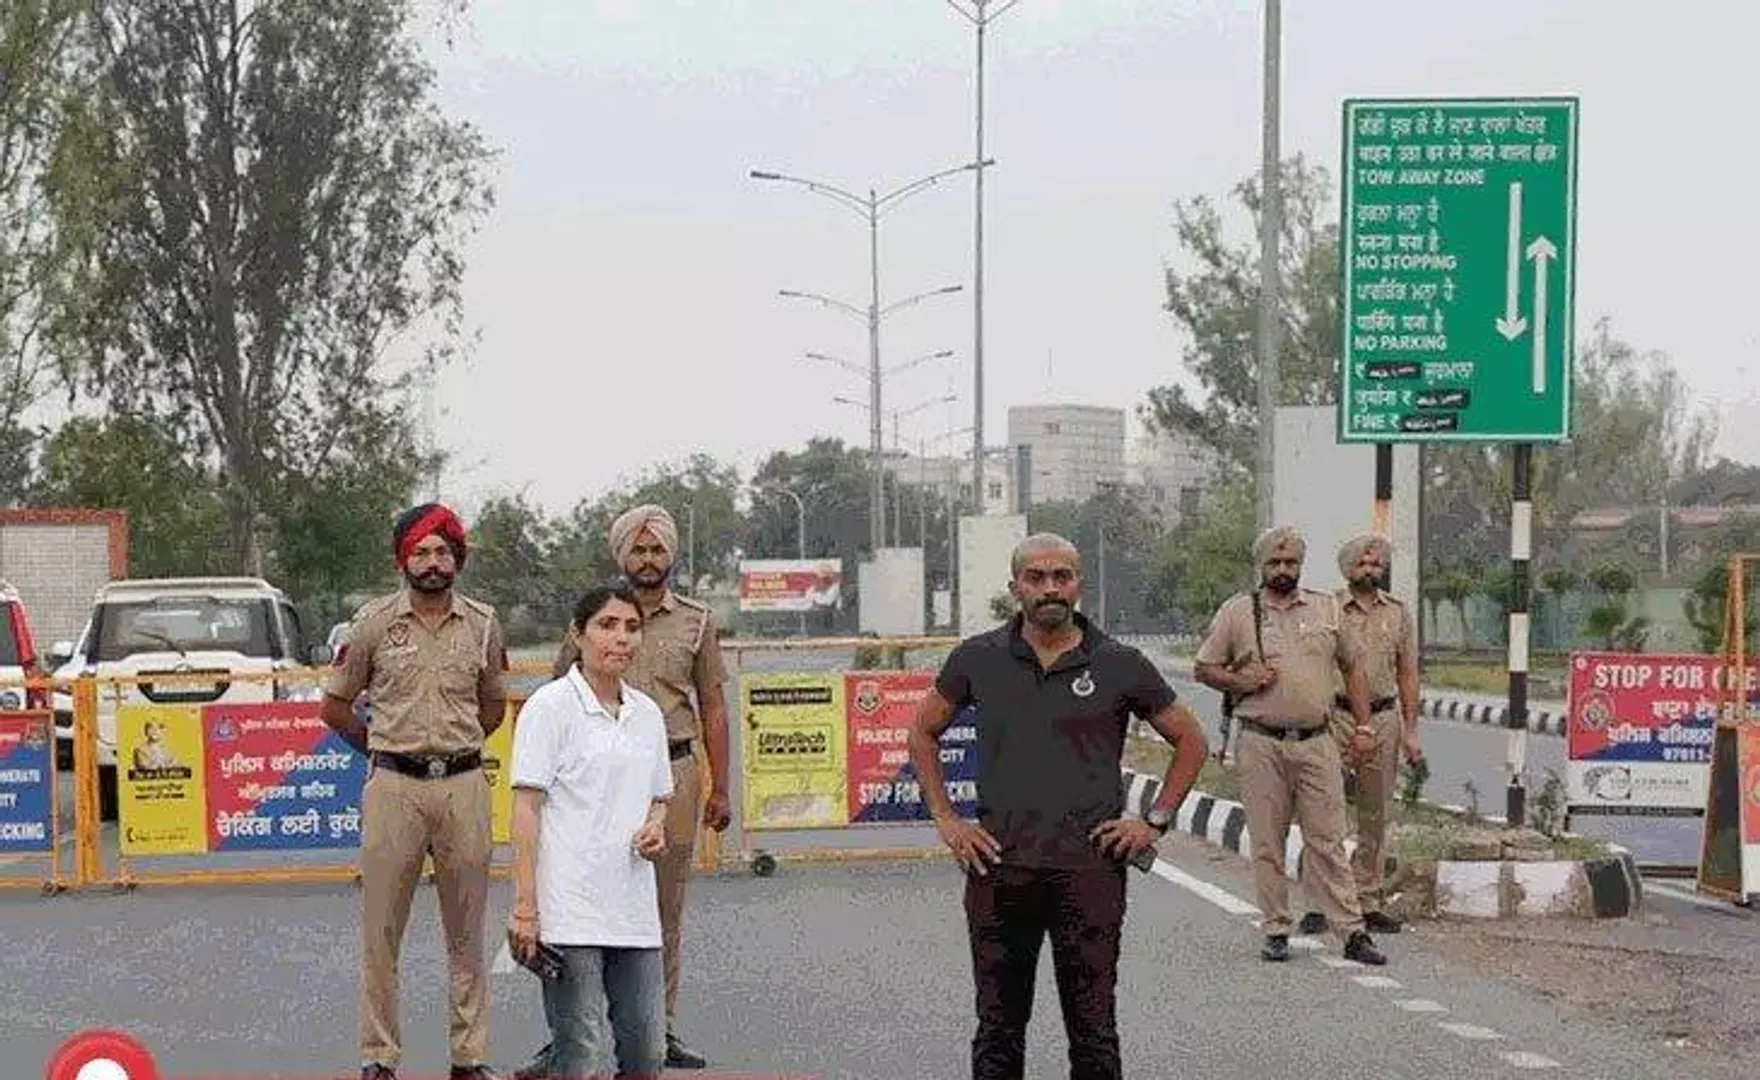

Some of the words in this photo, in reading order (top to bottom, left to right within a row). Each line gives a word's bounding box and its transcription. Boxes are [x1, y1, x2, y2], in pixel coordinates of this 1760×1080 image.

[1358, 169, 1394, 184] TOW
[1399, 169, 1440, 184] AWAY
[1444, 169, 1485, 184] ZONE
[1355, 255, 1378, 269] NO
[1382, 255, 1457, 269] STOPPING
[1354, 335, 1377, 350] NO
[1381, 335, 1447, 351] PARKING
[1353, 414, 1386, 429] FINE
[1595, 664, 1651, 688] STOP
[1660, 665, 1704, 689] FOR
[856, 728, 893, 745] POLICE
[938, 749, 966, 763] CITY
[220, 752, 265, 778] ਪੁਲਿਸ
[858, 782, 893, 804] STOP
[894, 781, 921, 803] FOR
[280, 807, 321, 835] ਲਈ
